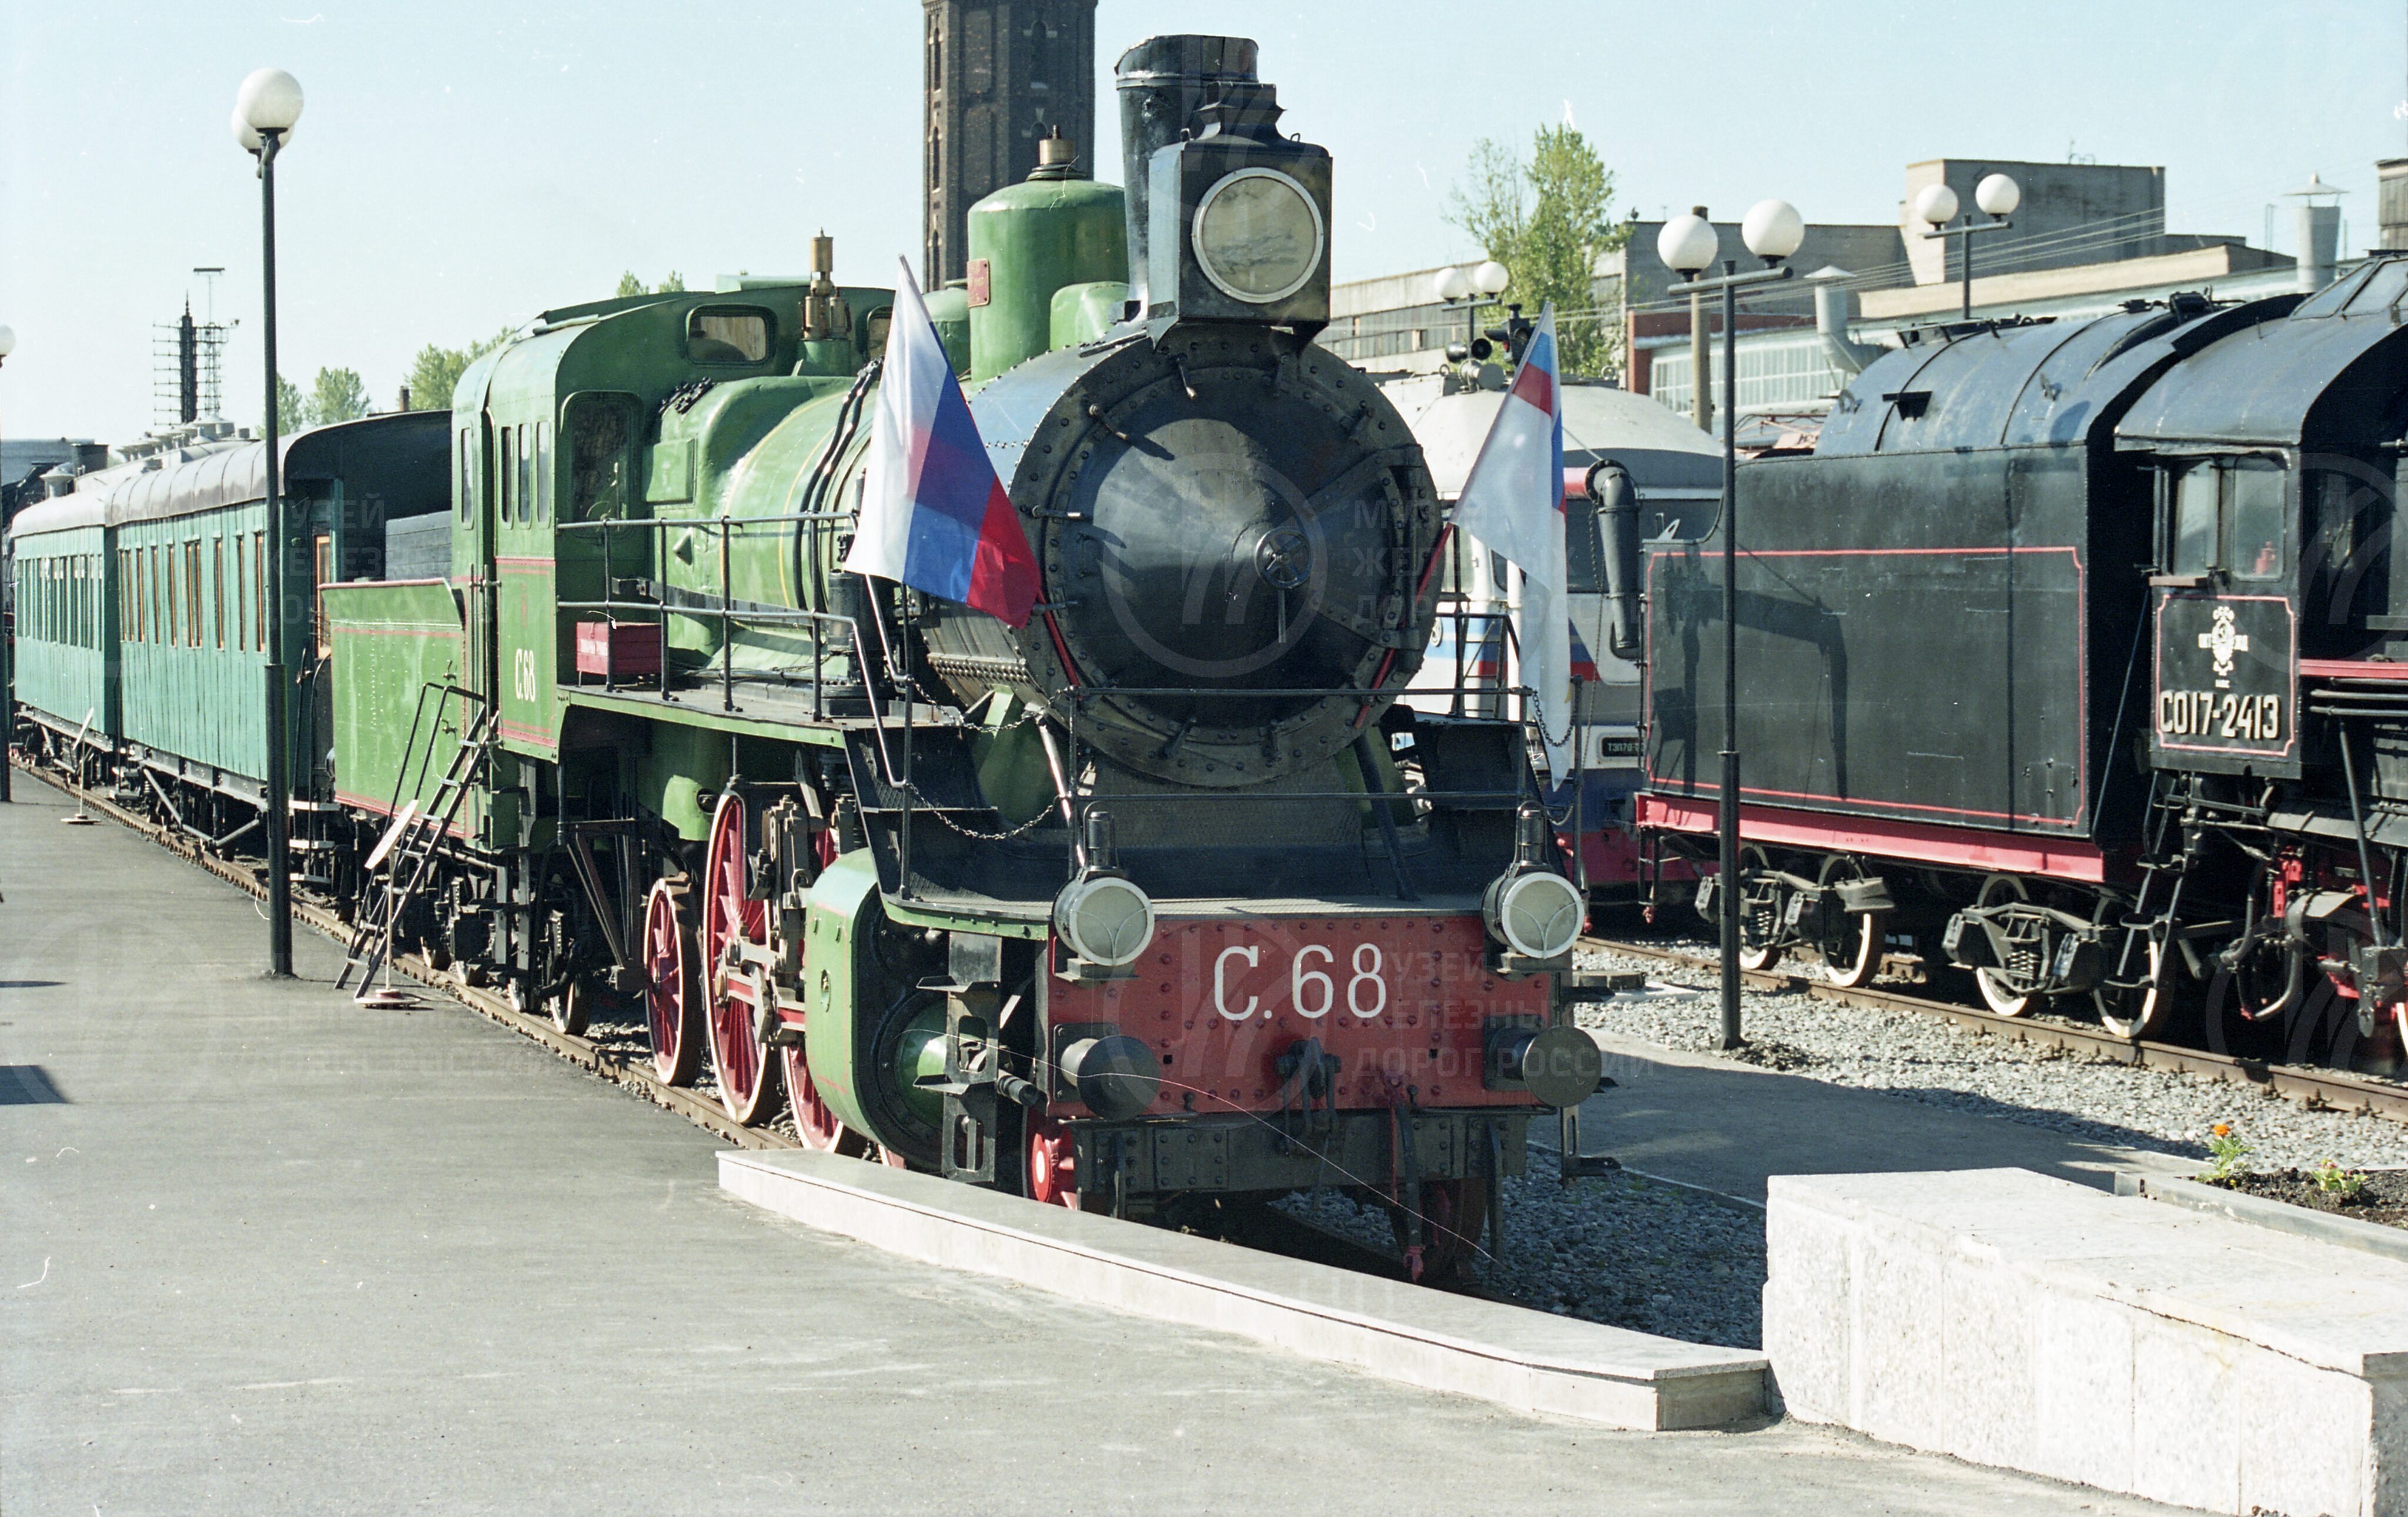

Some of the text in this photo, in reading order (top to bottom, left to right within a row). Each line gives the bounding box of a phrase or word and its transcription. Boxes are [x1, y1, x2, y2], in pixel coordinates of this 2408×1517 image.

[516, 649, 536, 703] С.68
[2159, 690, 2279, 740] СО17-2413
[1213, 942, 1387, 1021] С.68
